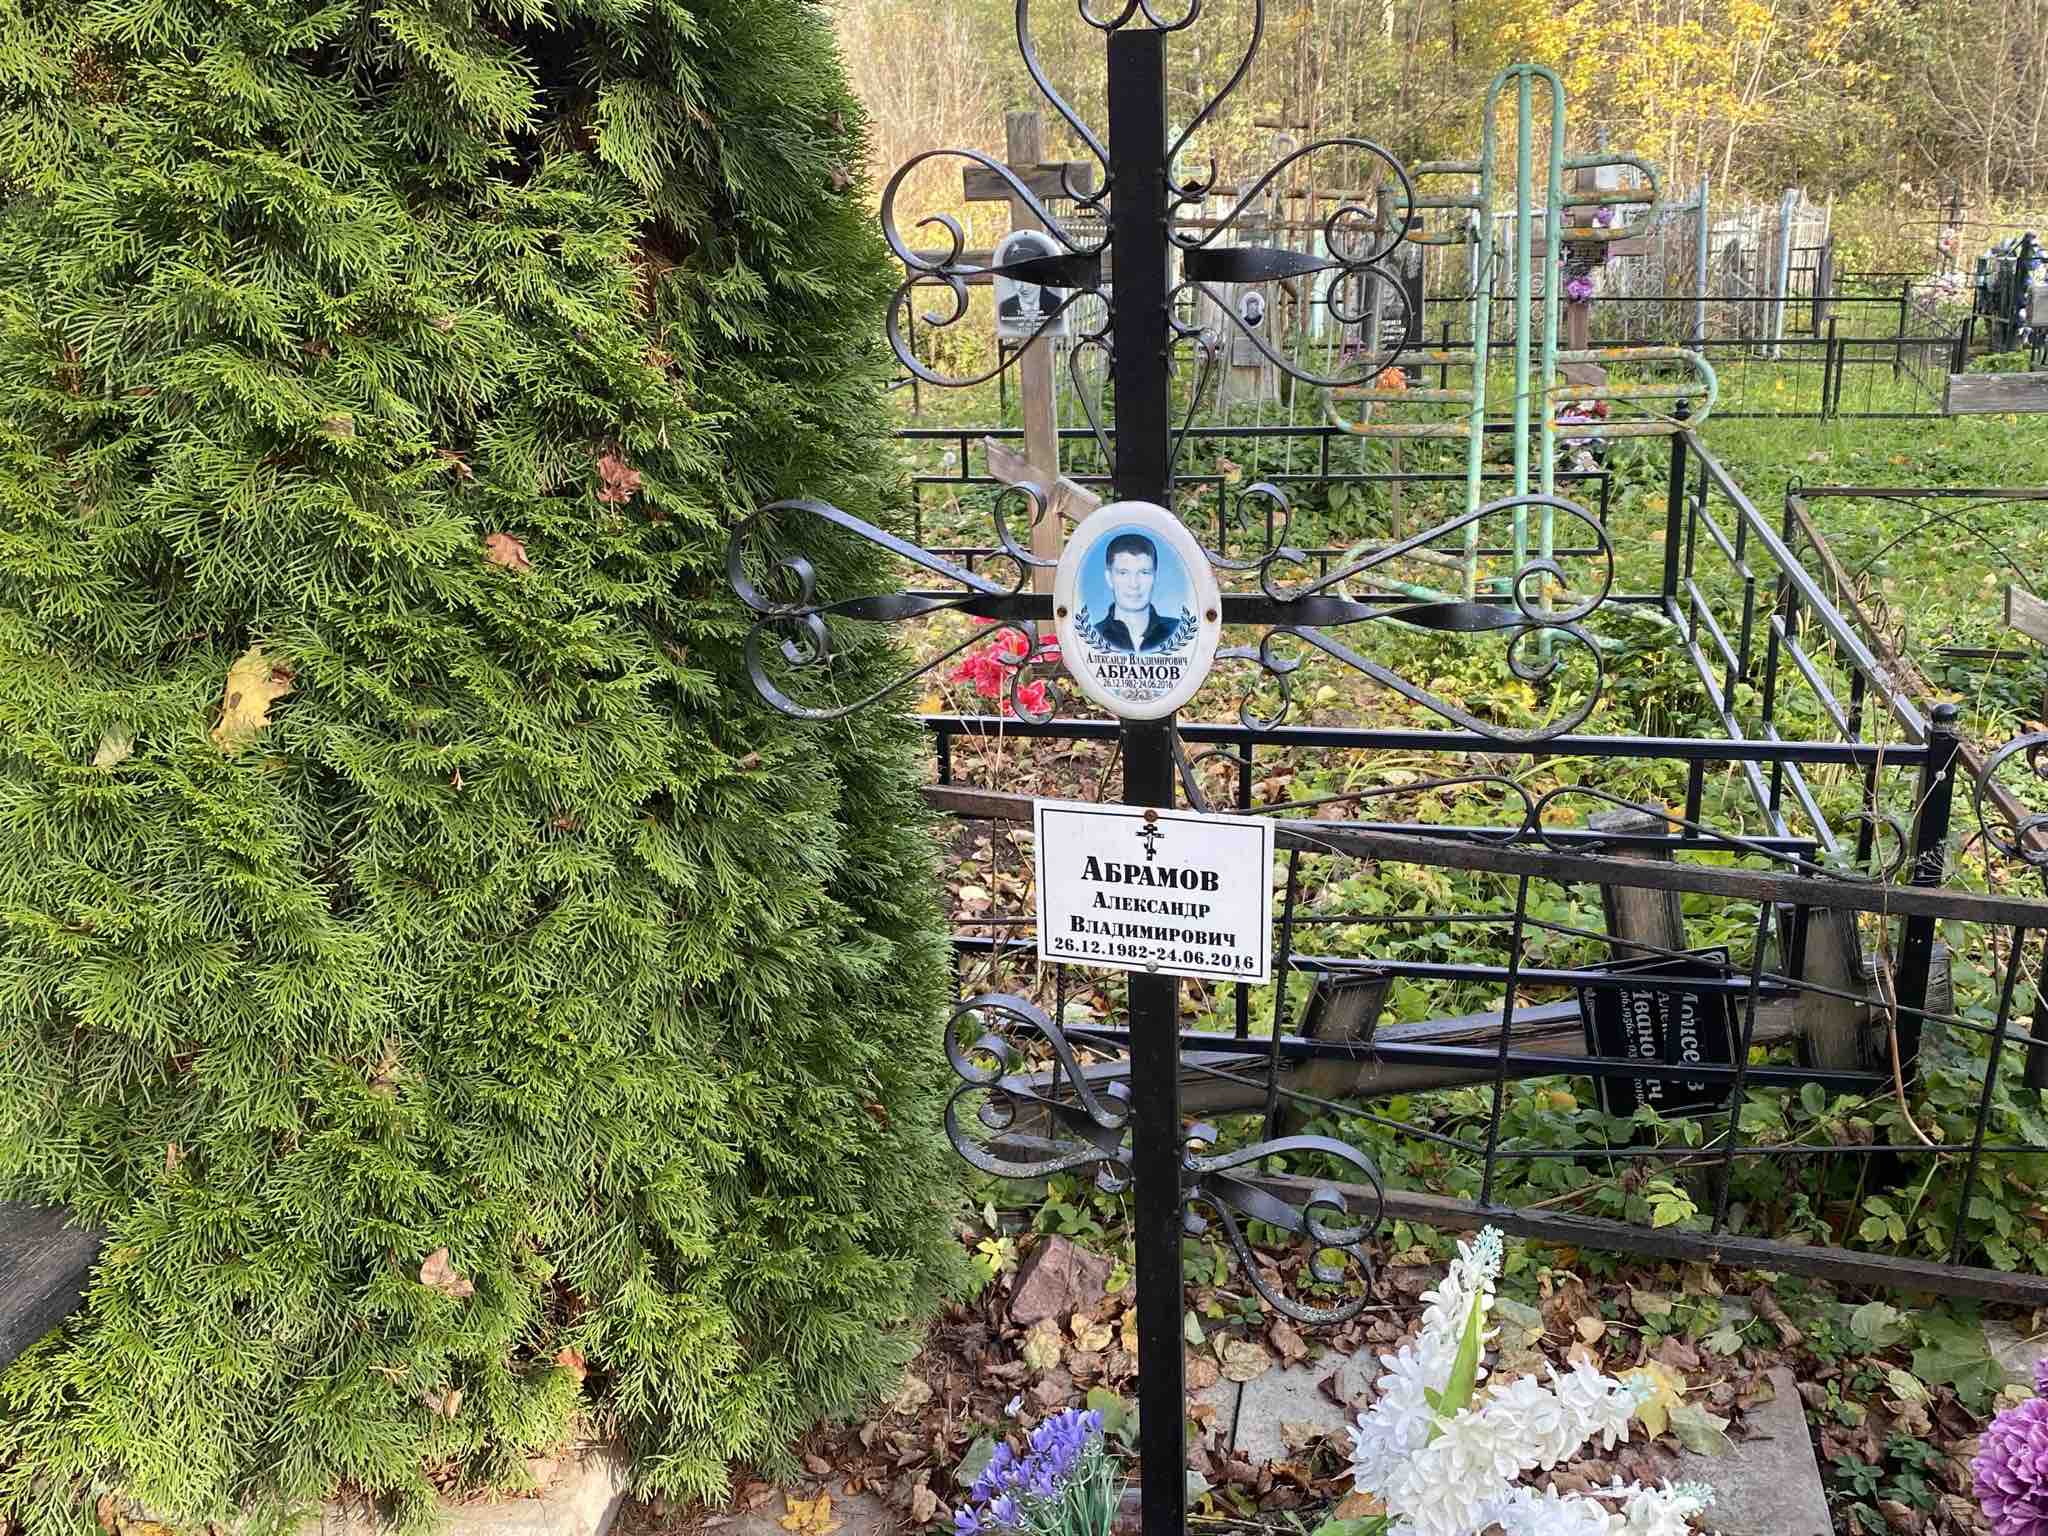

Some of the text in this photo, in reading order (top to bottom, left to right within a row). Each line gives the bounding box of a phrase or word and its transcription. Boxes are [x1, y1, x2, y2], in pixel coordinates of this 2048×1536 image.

[1096, 665, 1181, 680] АБРАМОВ
[1080, 855, 1220, 892] АБРАМОВ
[1054, 936, 1254, 969] 26.12.1982-24.06.2016
